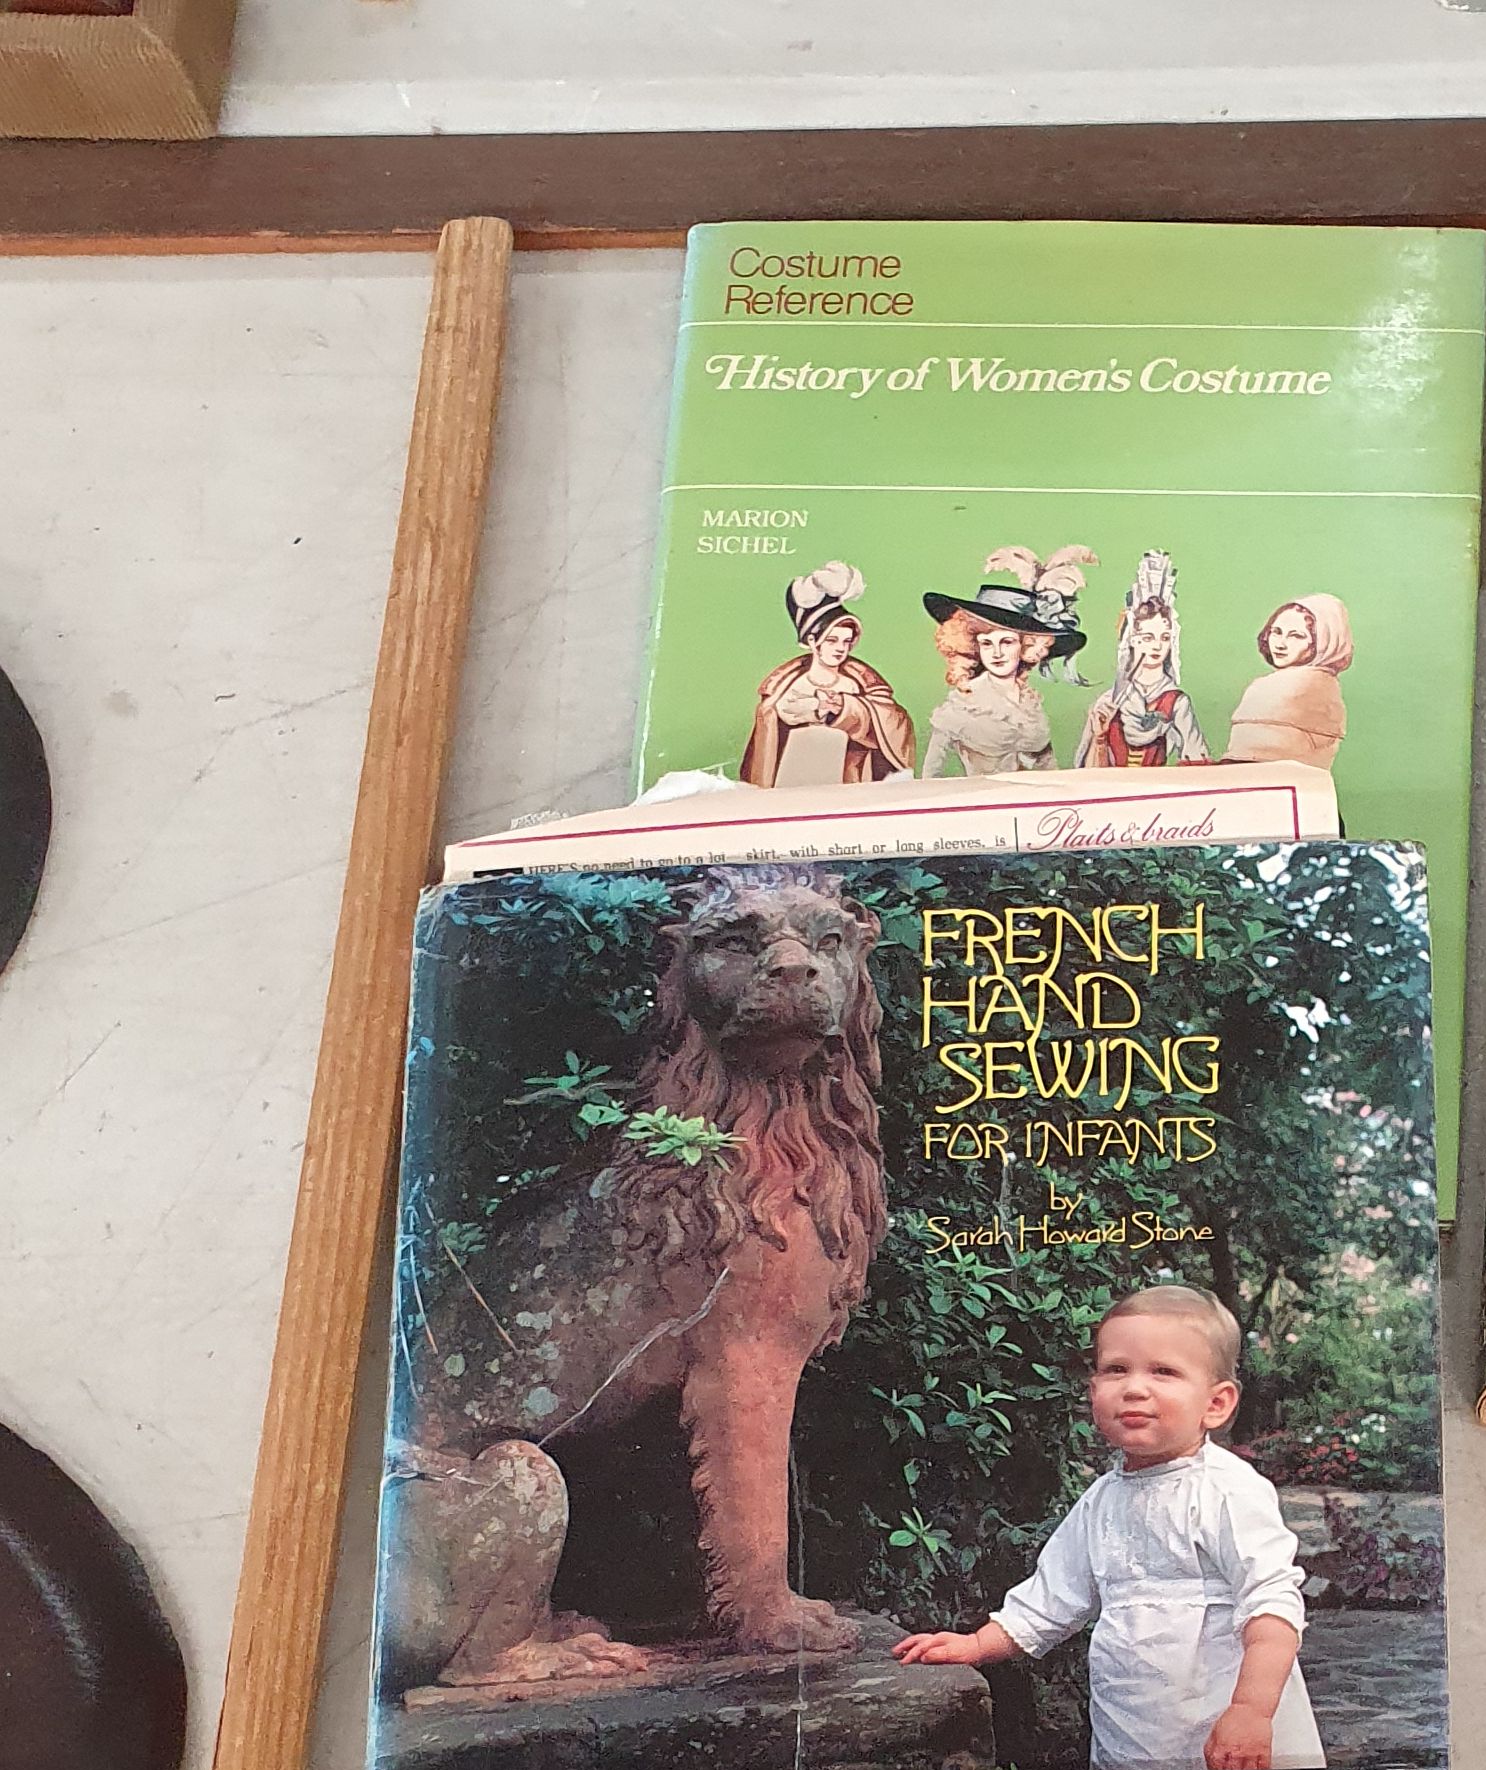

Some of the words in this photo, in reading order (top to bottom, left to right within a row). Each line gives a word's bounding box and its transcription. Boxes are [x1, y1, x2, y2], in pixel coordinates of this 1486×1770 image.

[730, 247, 902, 280] Costume
[725, 285, 914, 316] Reference
[705, 354, 883, 398] History
[886, 355, 938, 392] of
[948, 358, 1132, 395] Women's
[1139, 359, 1332, 397] Costume
[702, 510, 808, 528] MARION
[696, 536, 797, 555] SICHEL
[790, 844, 819, 858] with
[828, 843, 863, 856] short
[872, 844, 887, 854] or
[896, 840, 924, 854] long
[994, 835, 1006, 847] is
[1027, 807, 1116, 850] Plaits
[1141, 808, 1215, 842] braids
[922, 903, 1205, 979] FRENCH
[922, 973, 1141, 1048] HAND
[935, 1036, 1220, 1114] SEWING
[924, 1122, 1009, 1167] FOR
[1025, 1117, 1217, 1167] INFANTS
[1050, 1182, 1083, 1220] by
[925, 1216, 1012, 1254] Sarah
[1019, 1215, 1127, 1252] Howard
[1129, 1211, 1215, 1250] Stone
